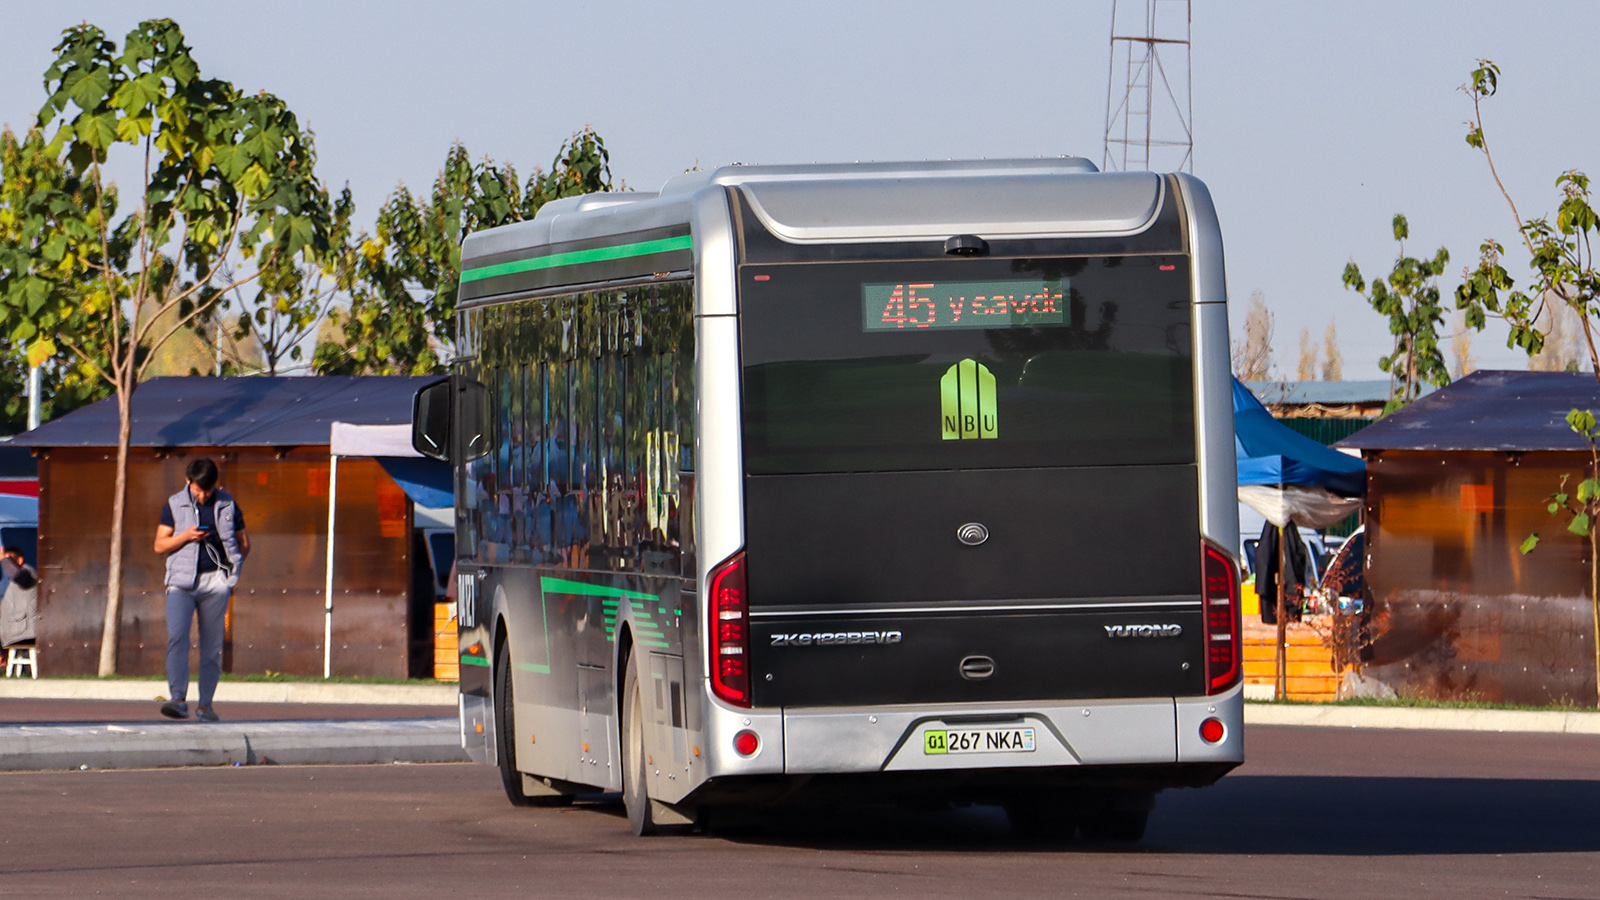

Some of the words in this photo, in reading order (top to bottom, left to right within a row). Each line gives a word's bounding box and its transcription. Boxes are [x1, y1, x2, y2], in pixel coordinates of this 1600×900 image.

[882, 283, 936, 328] 45
[945, 414, 995, 433] NBU
[1103, 623, 1183, 638] YUTONG
[928, 735, 946, 749] 01
[948, 732, 981, 751] 267
[986, 730, 1024, 750] NKA
